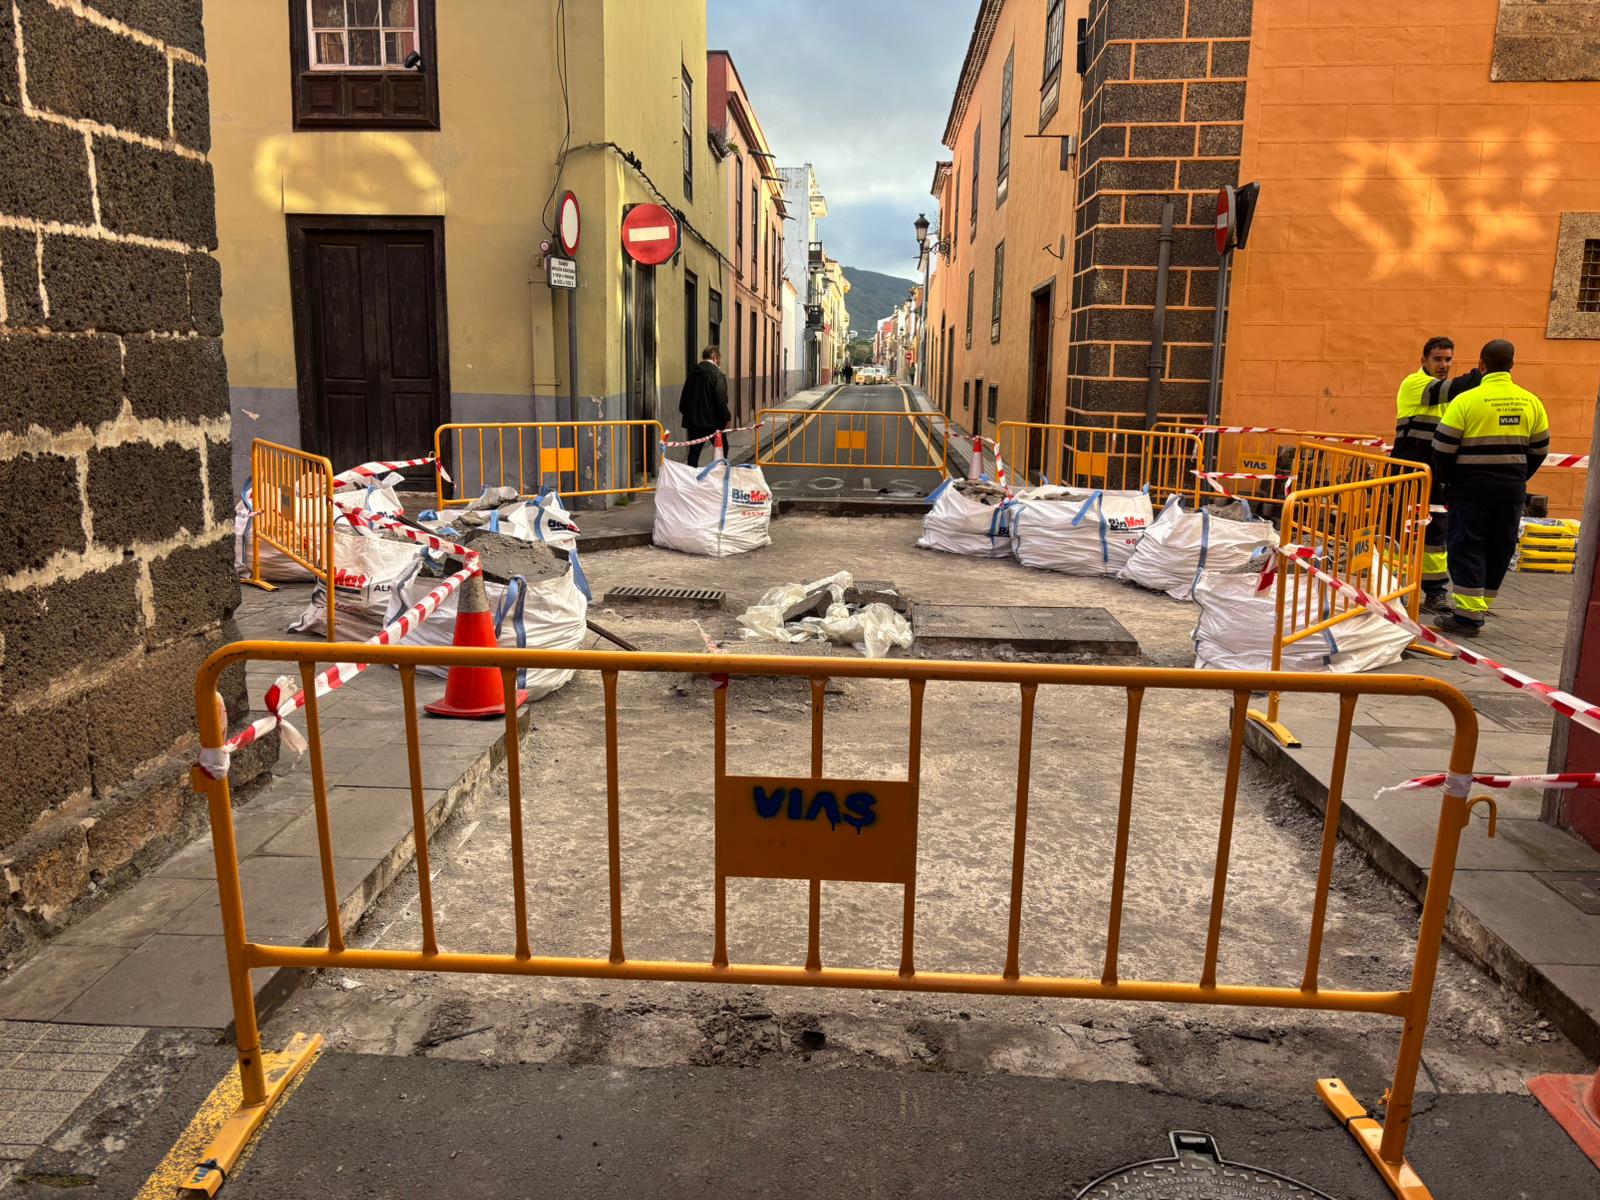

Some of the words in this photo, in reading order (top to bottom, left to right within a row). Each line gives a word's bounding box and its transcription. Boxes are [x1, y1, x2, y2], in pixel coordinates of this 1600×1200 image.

[1500, 416, 1519, 424] VIAS
[1243, 459, 1267, 471] VIAS
[1354, 539, 1370, 556] VIAS
[752, 785, 878, 832] VIAS
